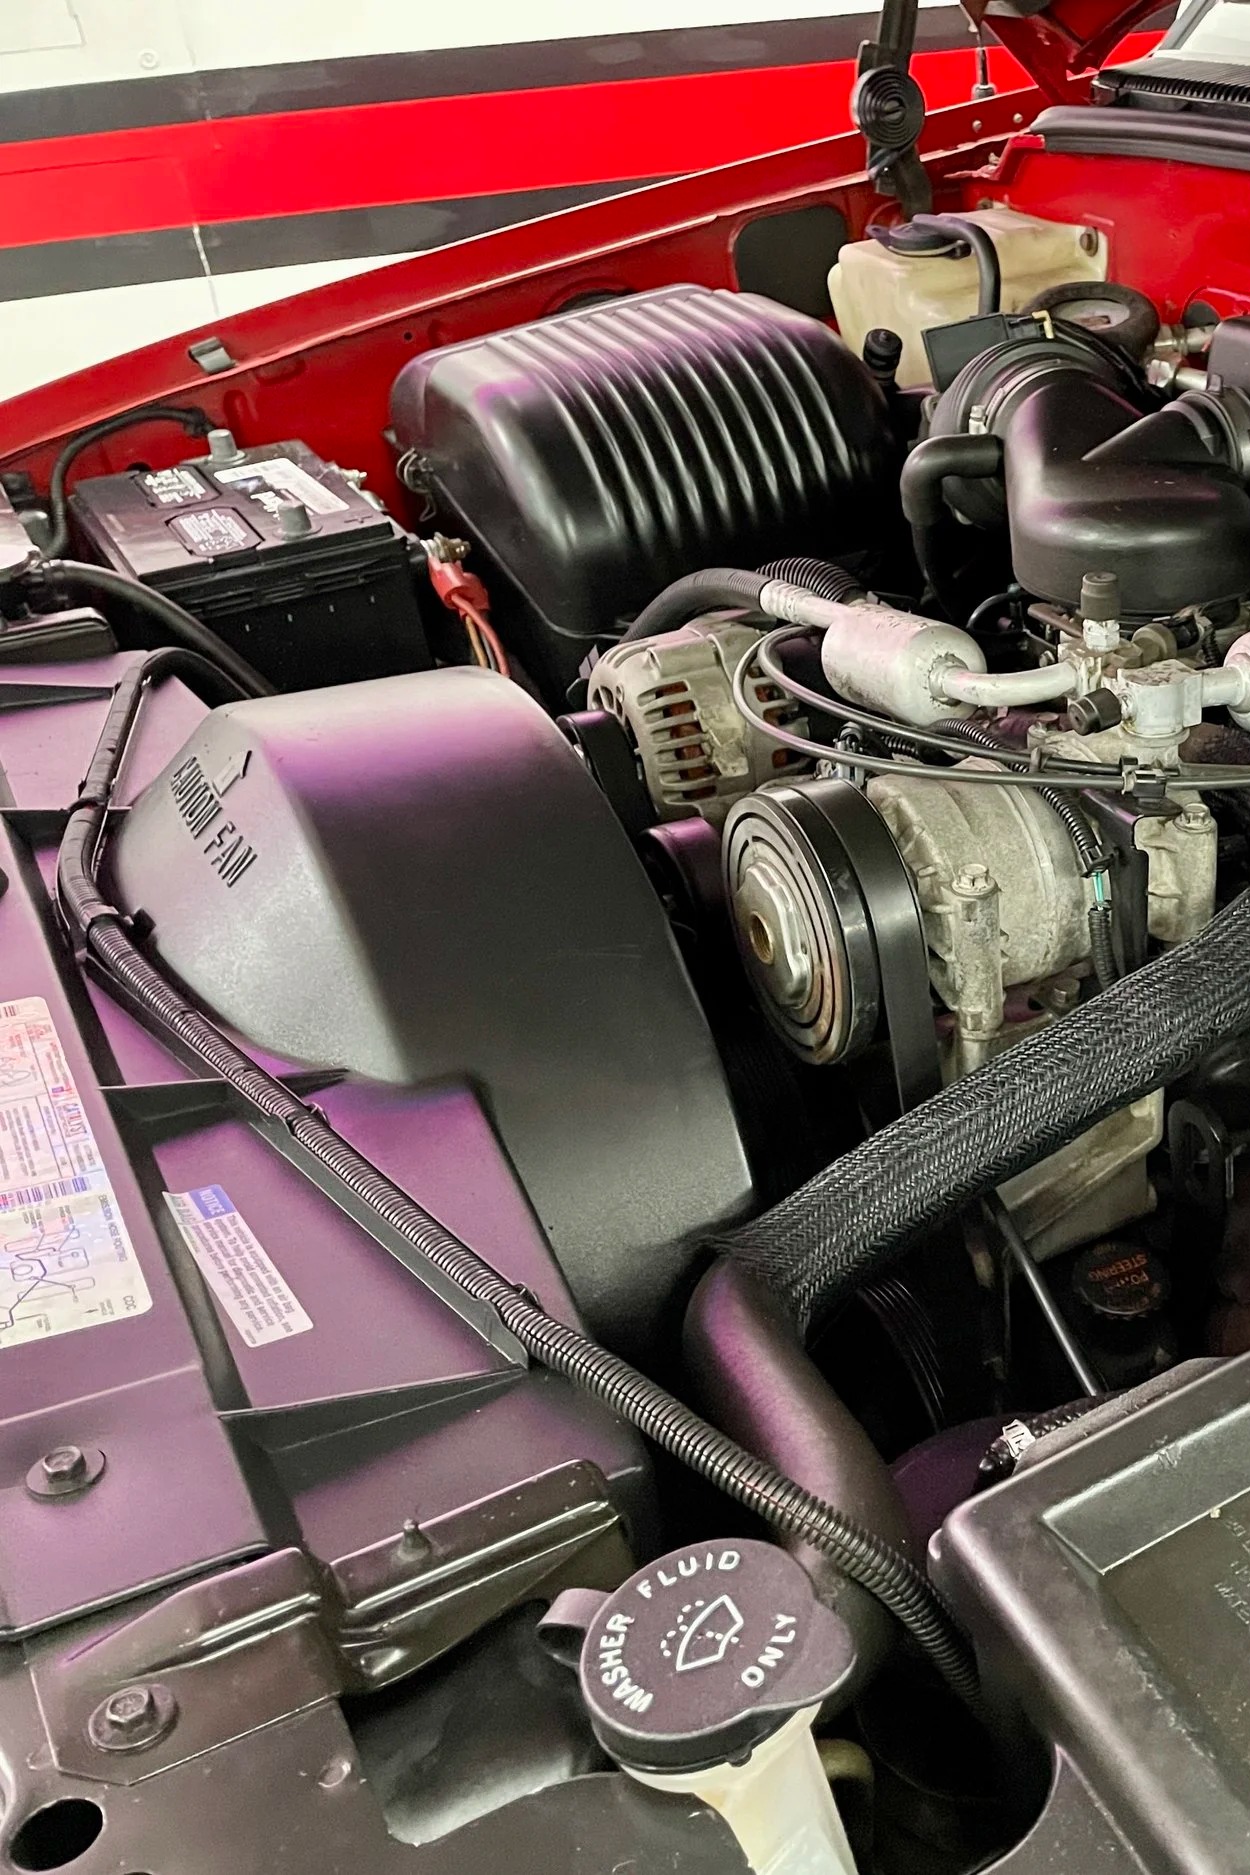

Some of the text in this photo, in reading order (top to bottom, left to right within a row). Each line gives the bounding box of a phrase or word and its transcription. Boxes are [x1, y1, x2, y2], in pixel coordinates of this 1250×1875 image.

[171, 756, 258, 888] CAUTION FAN
[199, 1188, 226, 1216] NOTICE
[1087, 1251, 1149, 1281] STEERING
[599, 1550, 798, 1713] WASHER FLUID ONLY
